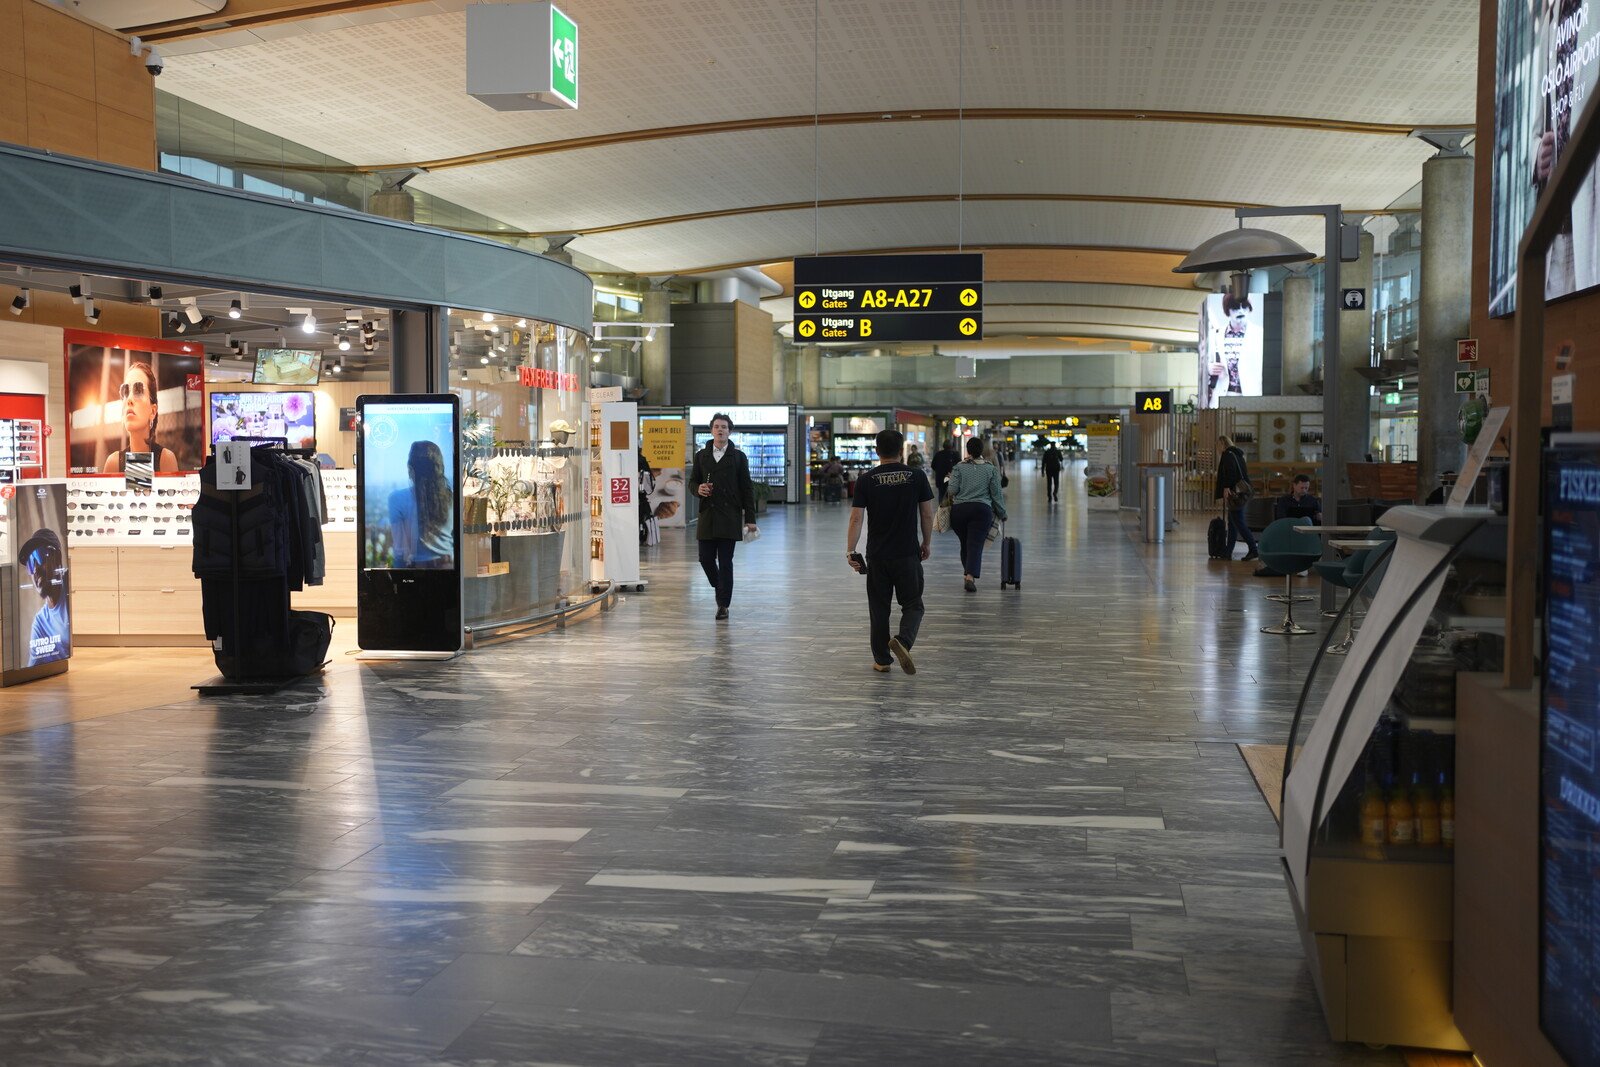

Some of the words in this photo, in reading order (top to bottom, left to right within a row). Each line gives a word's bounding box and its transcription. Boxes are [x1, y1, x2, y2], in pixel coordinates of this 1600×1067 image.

[1555, 2, 1589, 50] AVINOR
[1541, 62, 1564, 97] OSLO
[1563, 31, 1600, 81] AIRPORT
[1551, 94, 1568, 120] SHOP
[1575, 80, 1586, 102] FLY
[822, 289, 855, 300] Utgang
[860, 289, 933, 308] A8-A27
[822, 300, 848, 309] Gates
[821, 318, 854, 329] Utgang
[859, 319, 873, 337] B
[821, 328, 848, 338] Gates
[519, 366, 536, 387] TAX
[536, 368, 554, 389] FREE
[1143, 397, 1162, 411] A8
[878, 473, 907, 484] ITALIA
[30, 636, 49, 648] SUTRO
[49, 634, 62, 645] LITE
[35, 643, 56, 655] SWEEP
